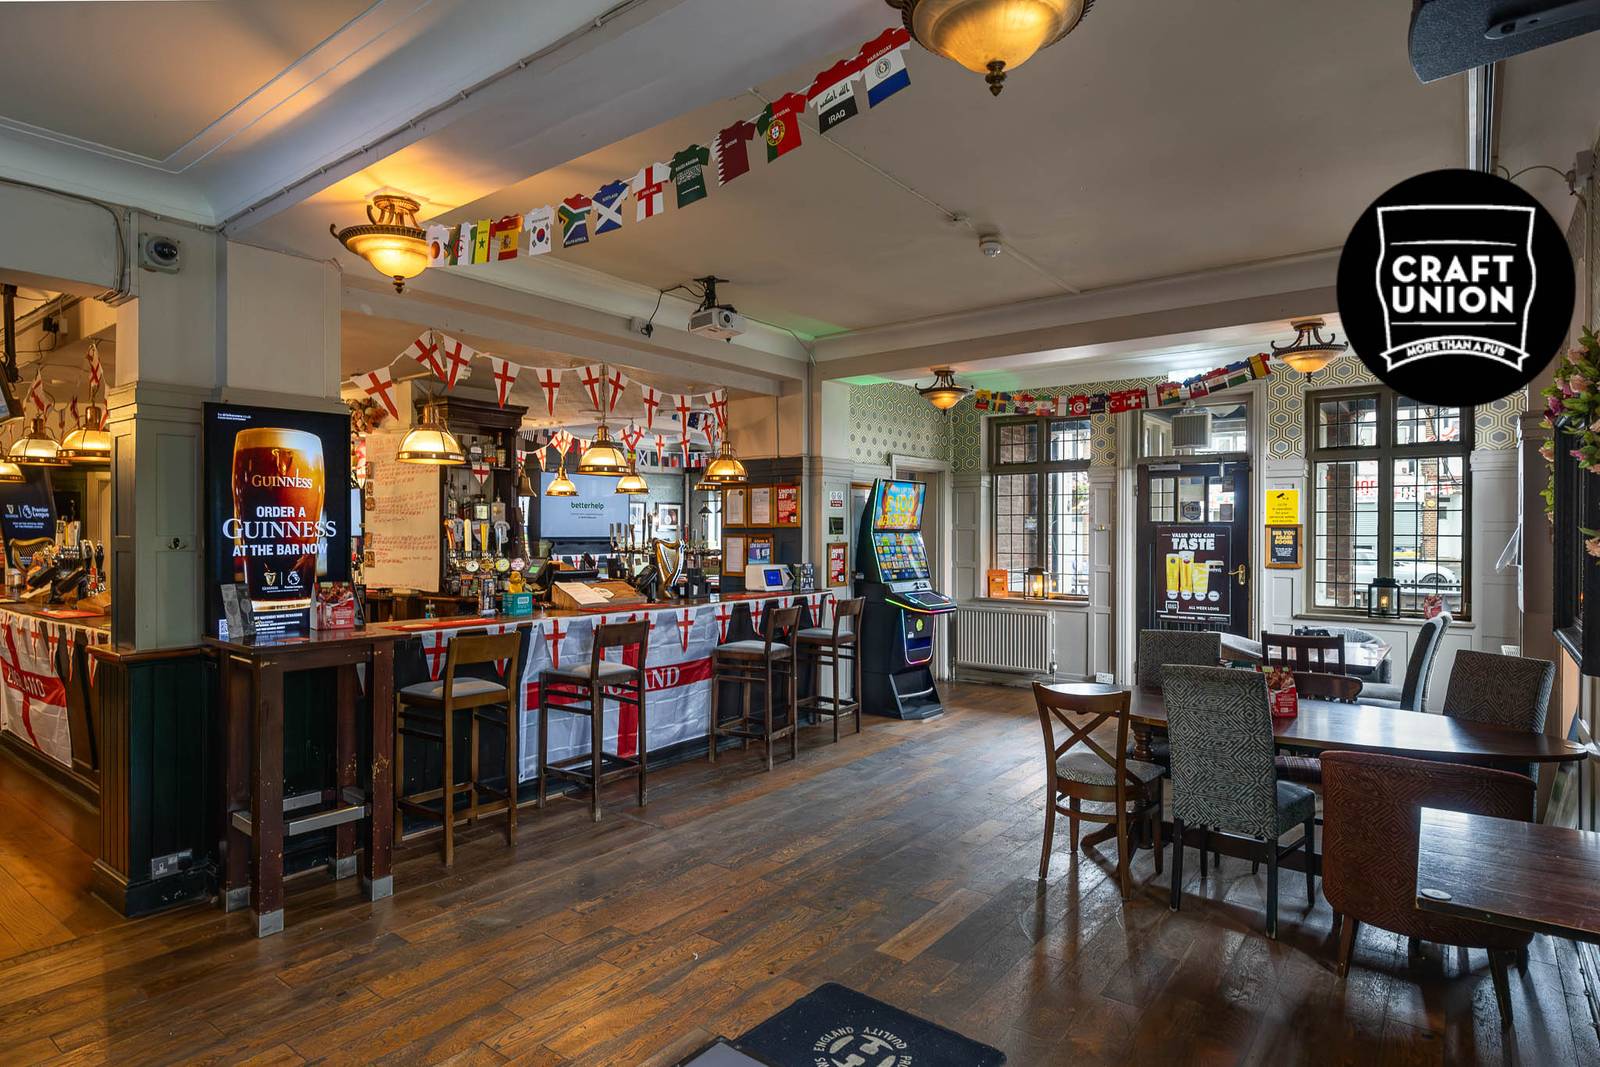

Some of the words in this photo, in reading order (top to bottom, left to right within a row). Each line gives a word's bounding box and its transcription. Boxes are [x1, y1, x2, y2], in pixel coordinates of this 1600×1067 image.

[867, 44, 892, 63] PARAGUAY
[769, 107, 791, 122] PORTUGAL
[828, 108, 847, 124] IRAQ
[251, 474, 313, 489] GUINNESS
[256, 506, 295, 518] ORDER
[298, 506, 307, 518] A
[570, 502, 605, 511] betterhelp
[222, 518, 337, 539] GUINNESS
[232, 545, 248, 557] AT
[250, 544, 273, 556] THE
[276, 543, 299, 556] BAR
[302, 543, 328, 554] NOW
[1171, 538, 1216, 551] TASTE
[813, 1026, 854, 1052] ENGLAND
[863, 1026, 908, 1050] QUALITY
